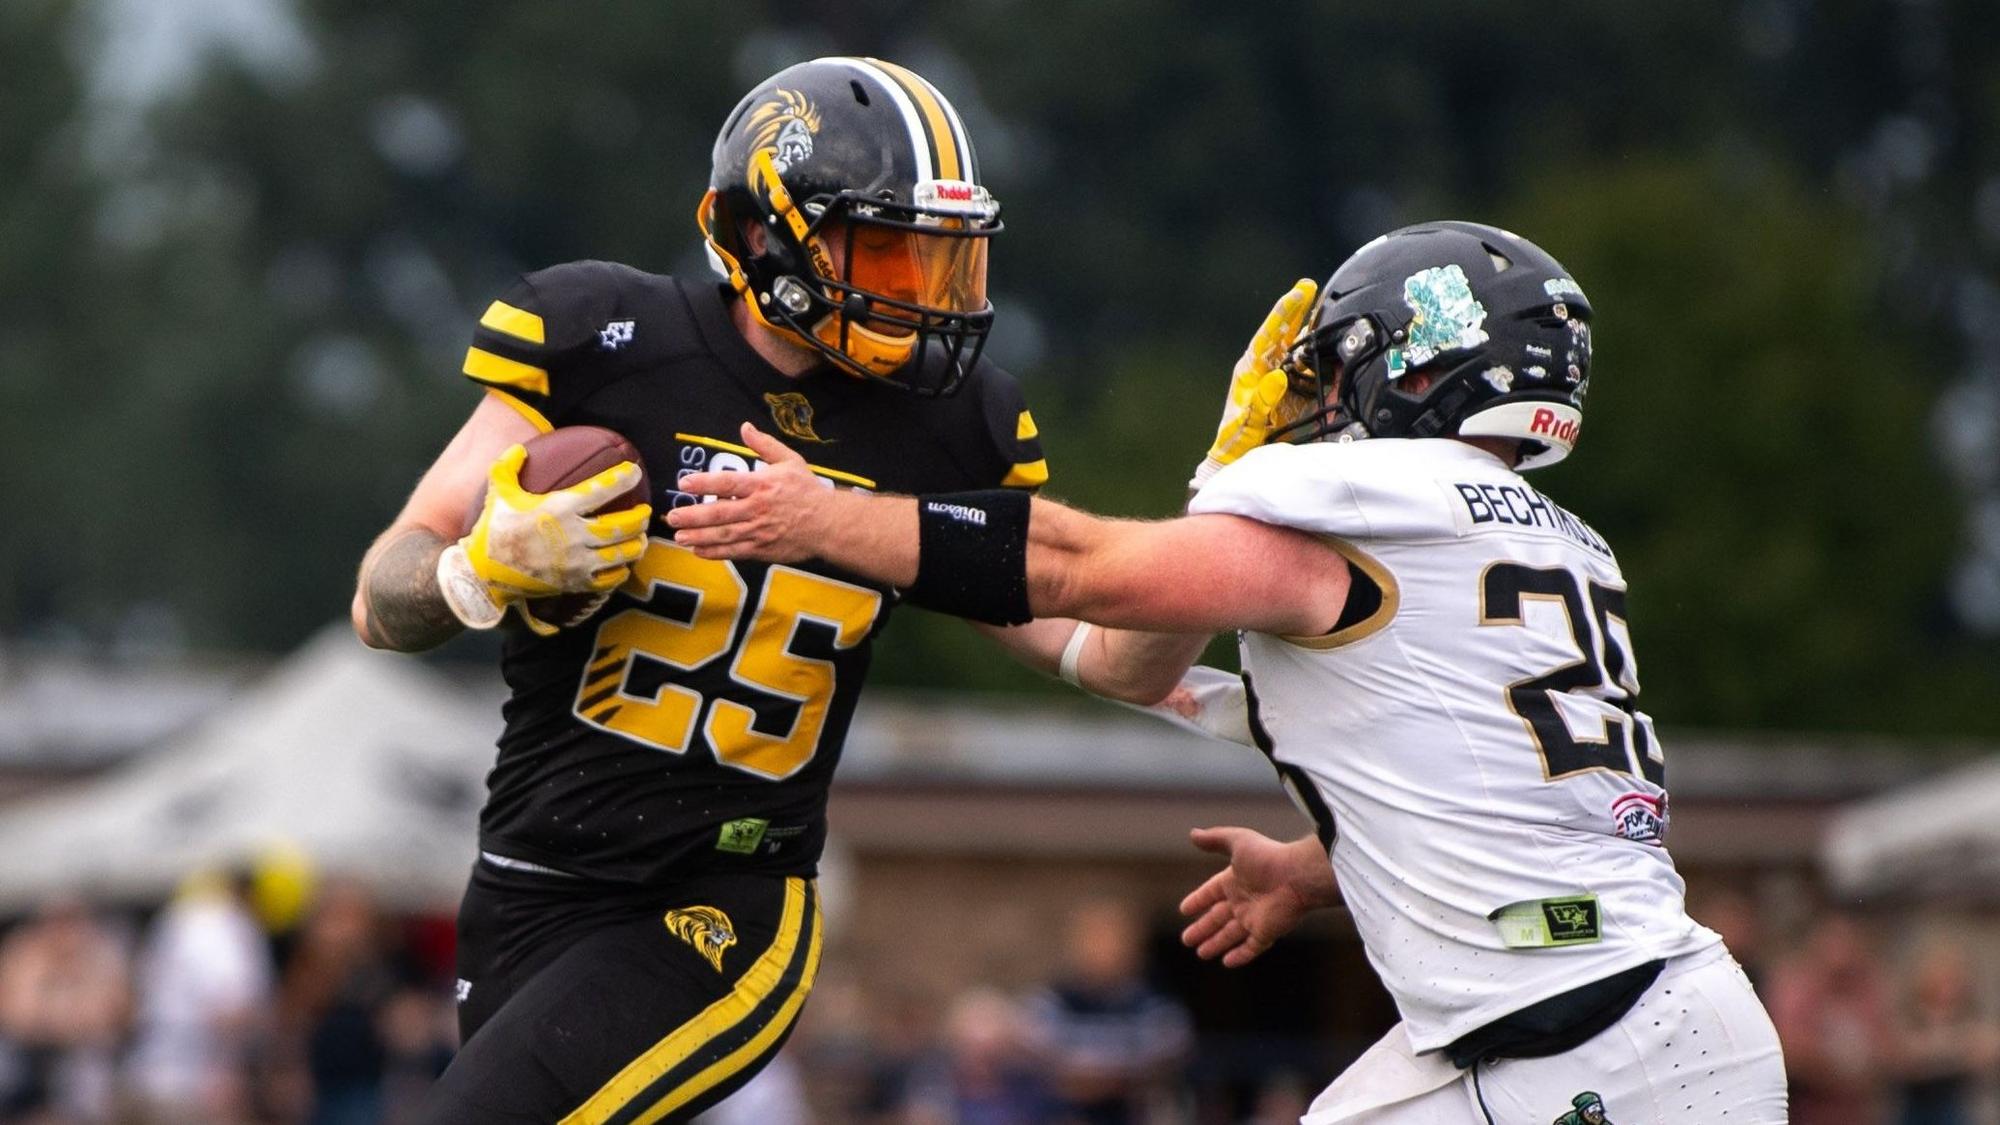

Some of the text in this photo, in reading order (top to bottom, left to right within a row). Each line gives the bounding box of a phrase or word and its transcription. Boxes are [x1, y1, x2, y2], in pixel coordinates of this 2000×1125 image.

[928, 502, 987, 526] Wilson
[572, 537, 882, 782] 25
[1521, 928, 1534, 941] M
